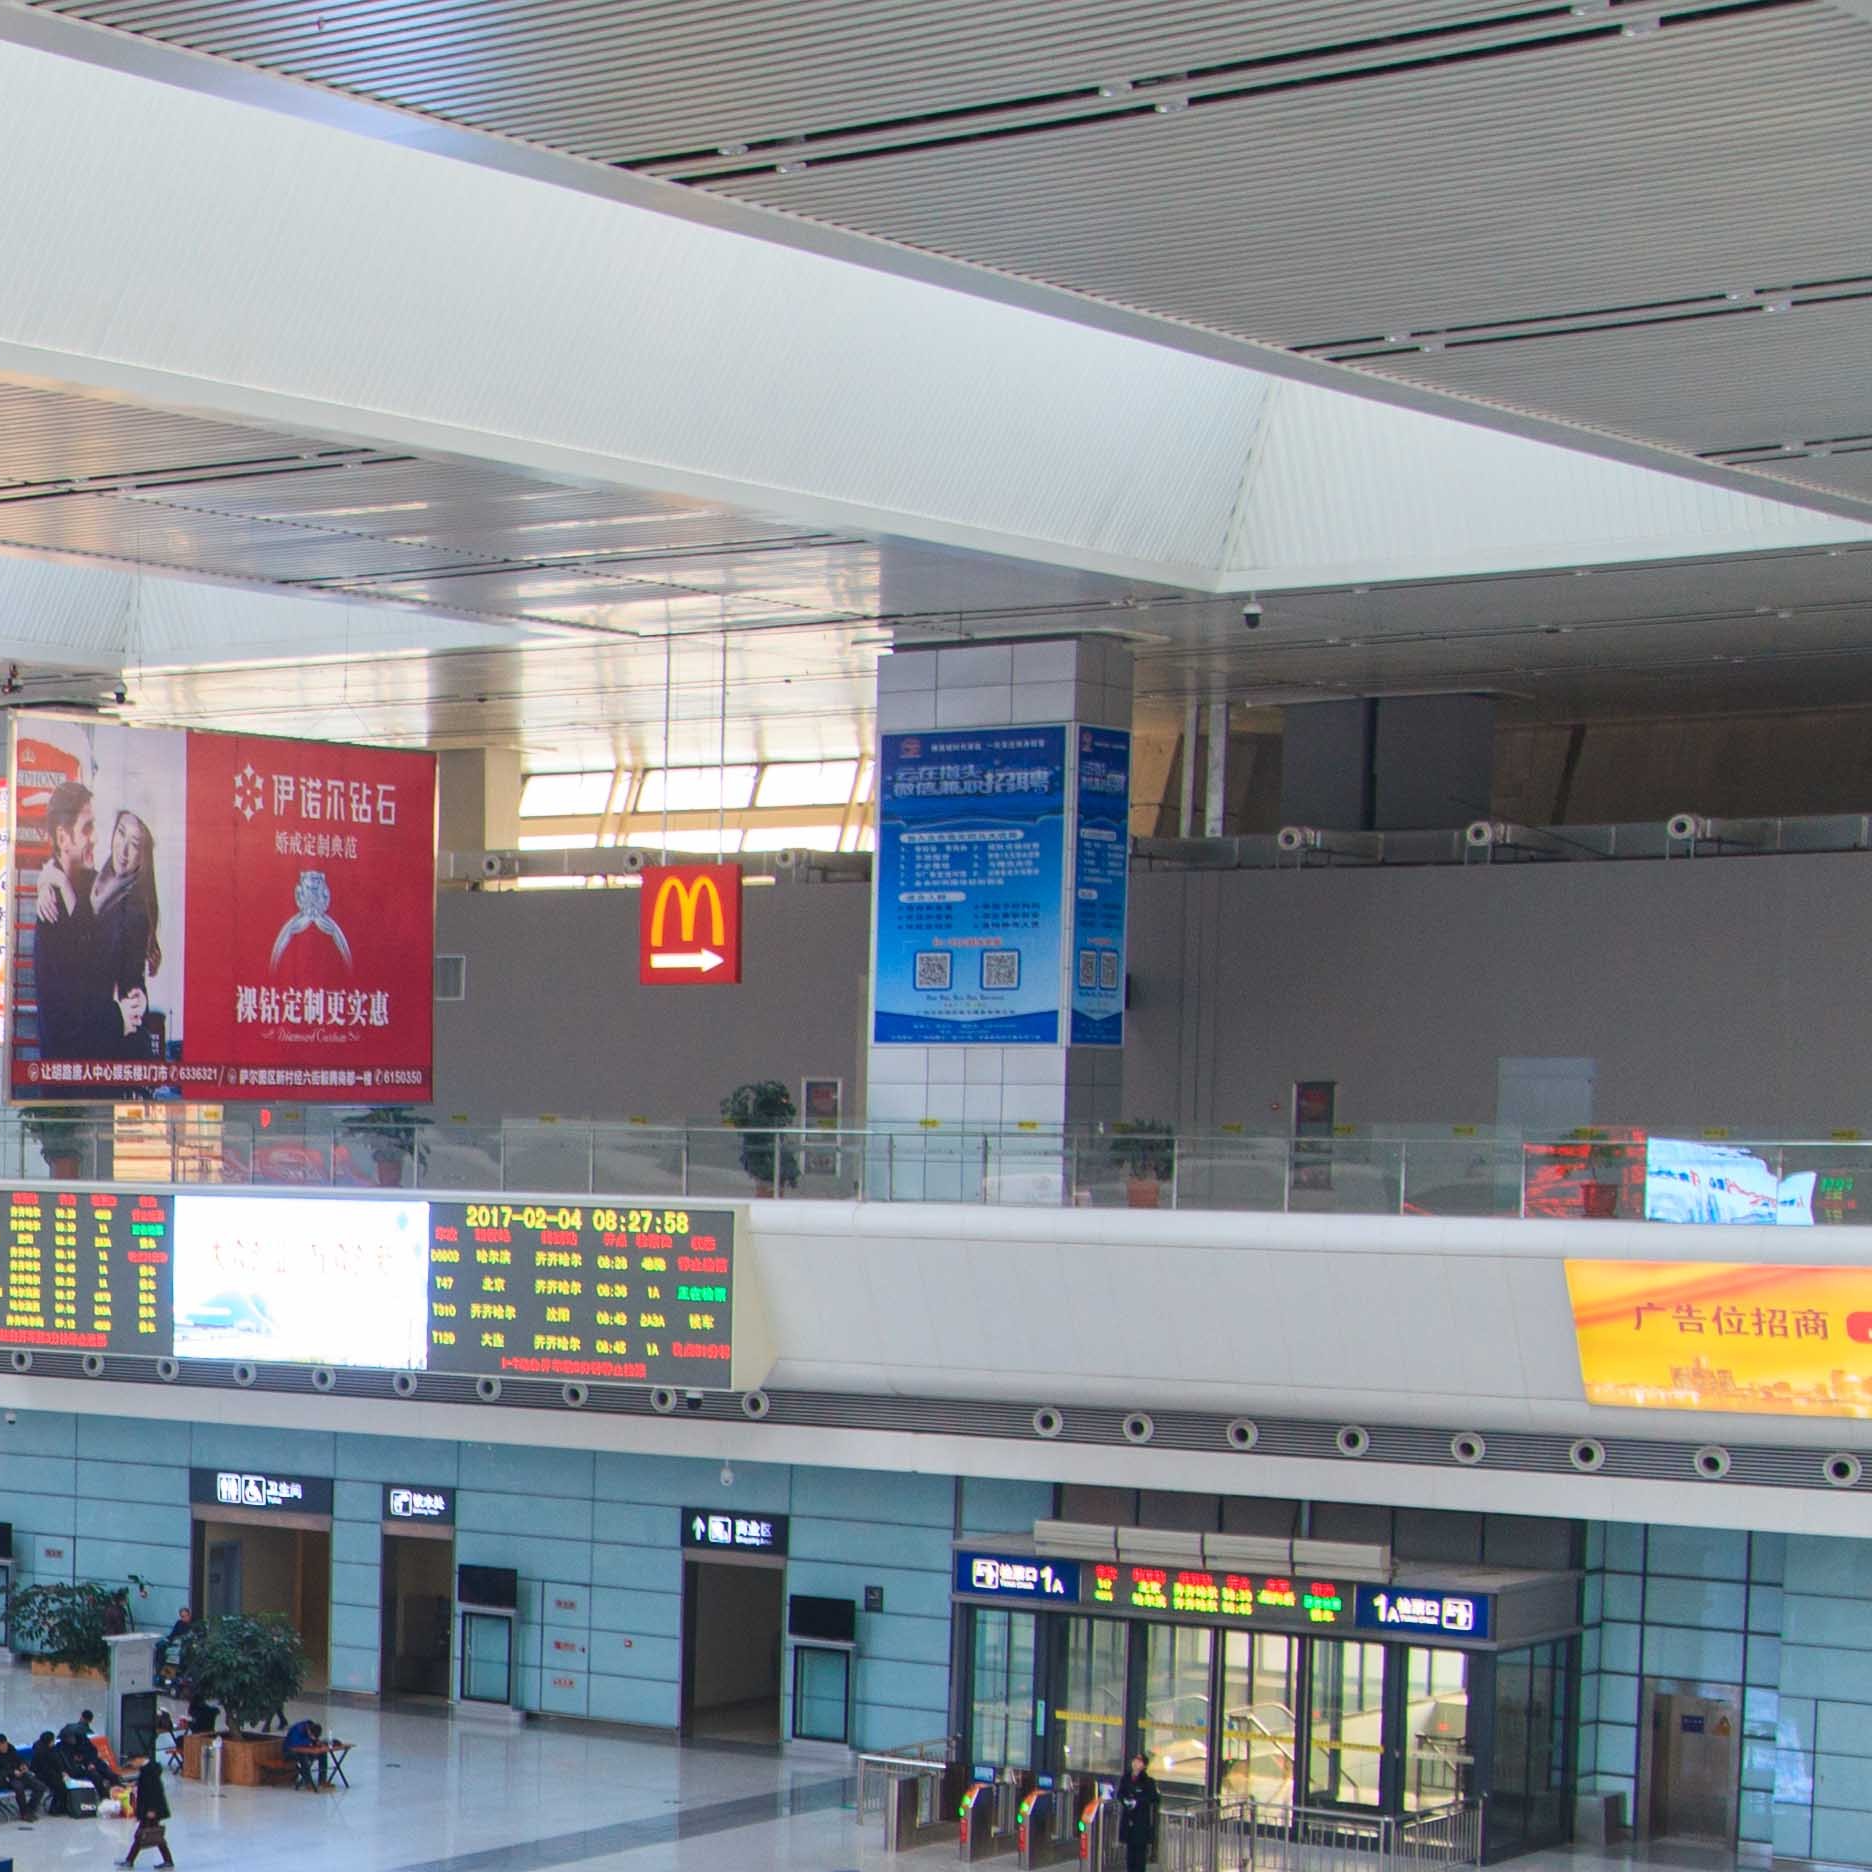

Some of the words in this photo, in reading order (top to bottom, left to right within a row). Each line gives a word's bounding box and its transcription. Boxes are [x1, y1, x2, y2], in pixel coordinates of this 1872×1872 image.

[272, 774, 397, 825] 伊诺尔钻石
[275, 831, 359, 859] 婚戒定制典范
[236, 985, 390, 1027] 裸钻定制更实惠
[466, 1203, 583, 1231] 2017-02-04
[592, 1207, 689, 1235] 08:27:58
[1632, 1302, 1830, 1341] 广告位招商
[267, 1479, 303, 1499] 卫生间
[1040, 1565, 1065, 1594] 1A
[1372, 1592, 1401, 1622] 1A
